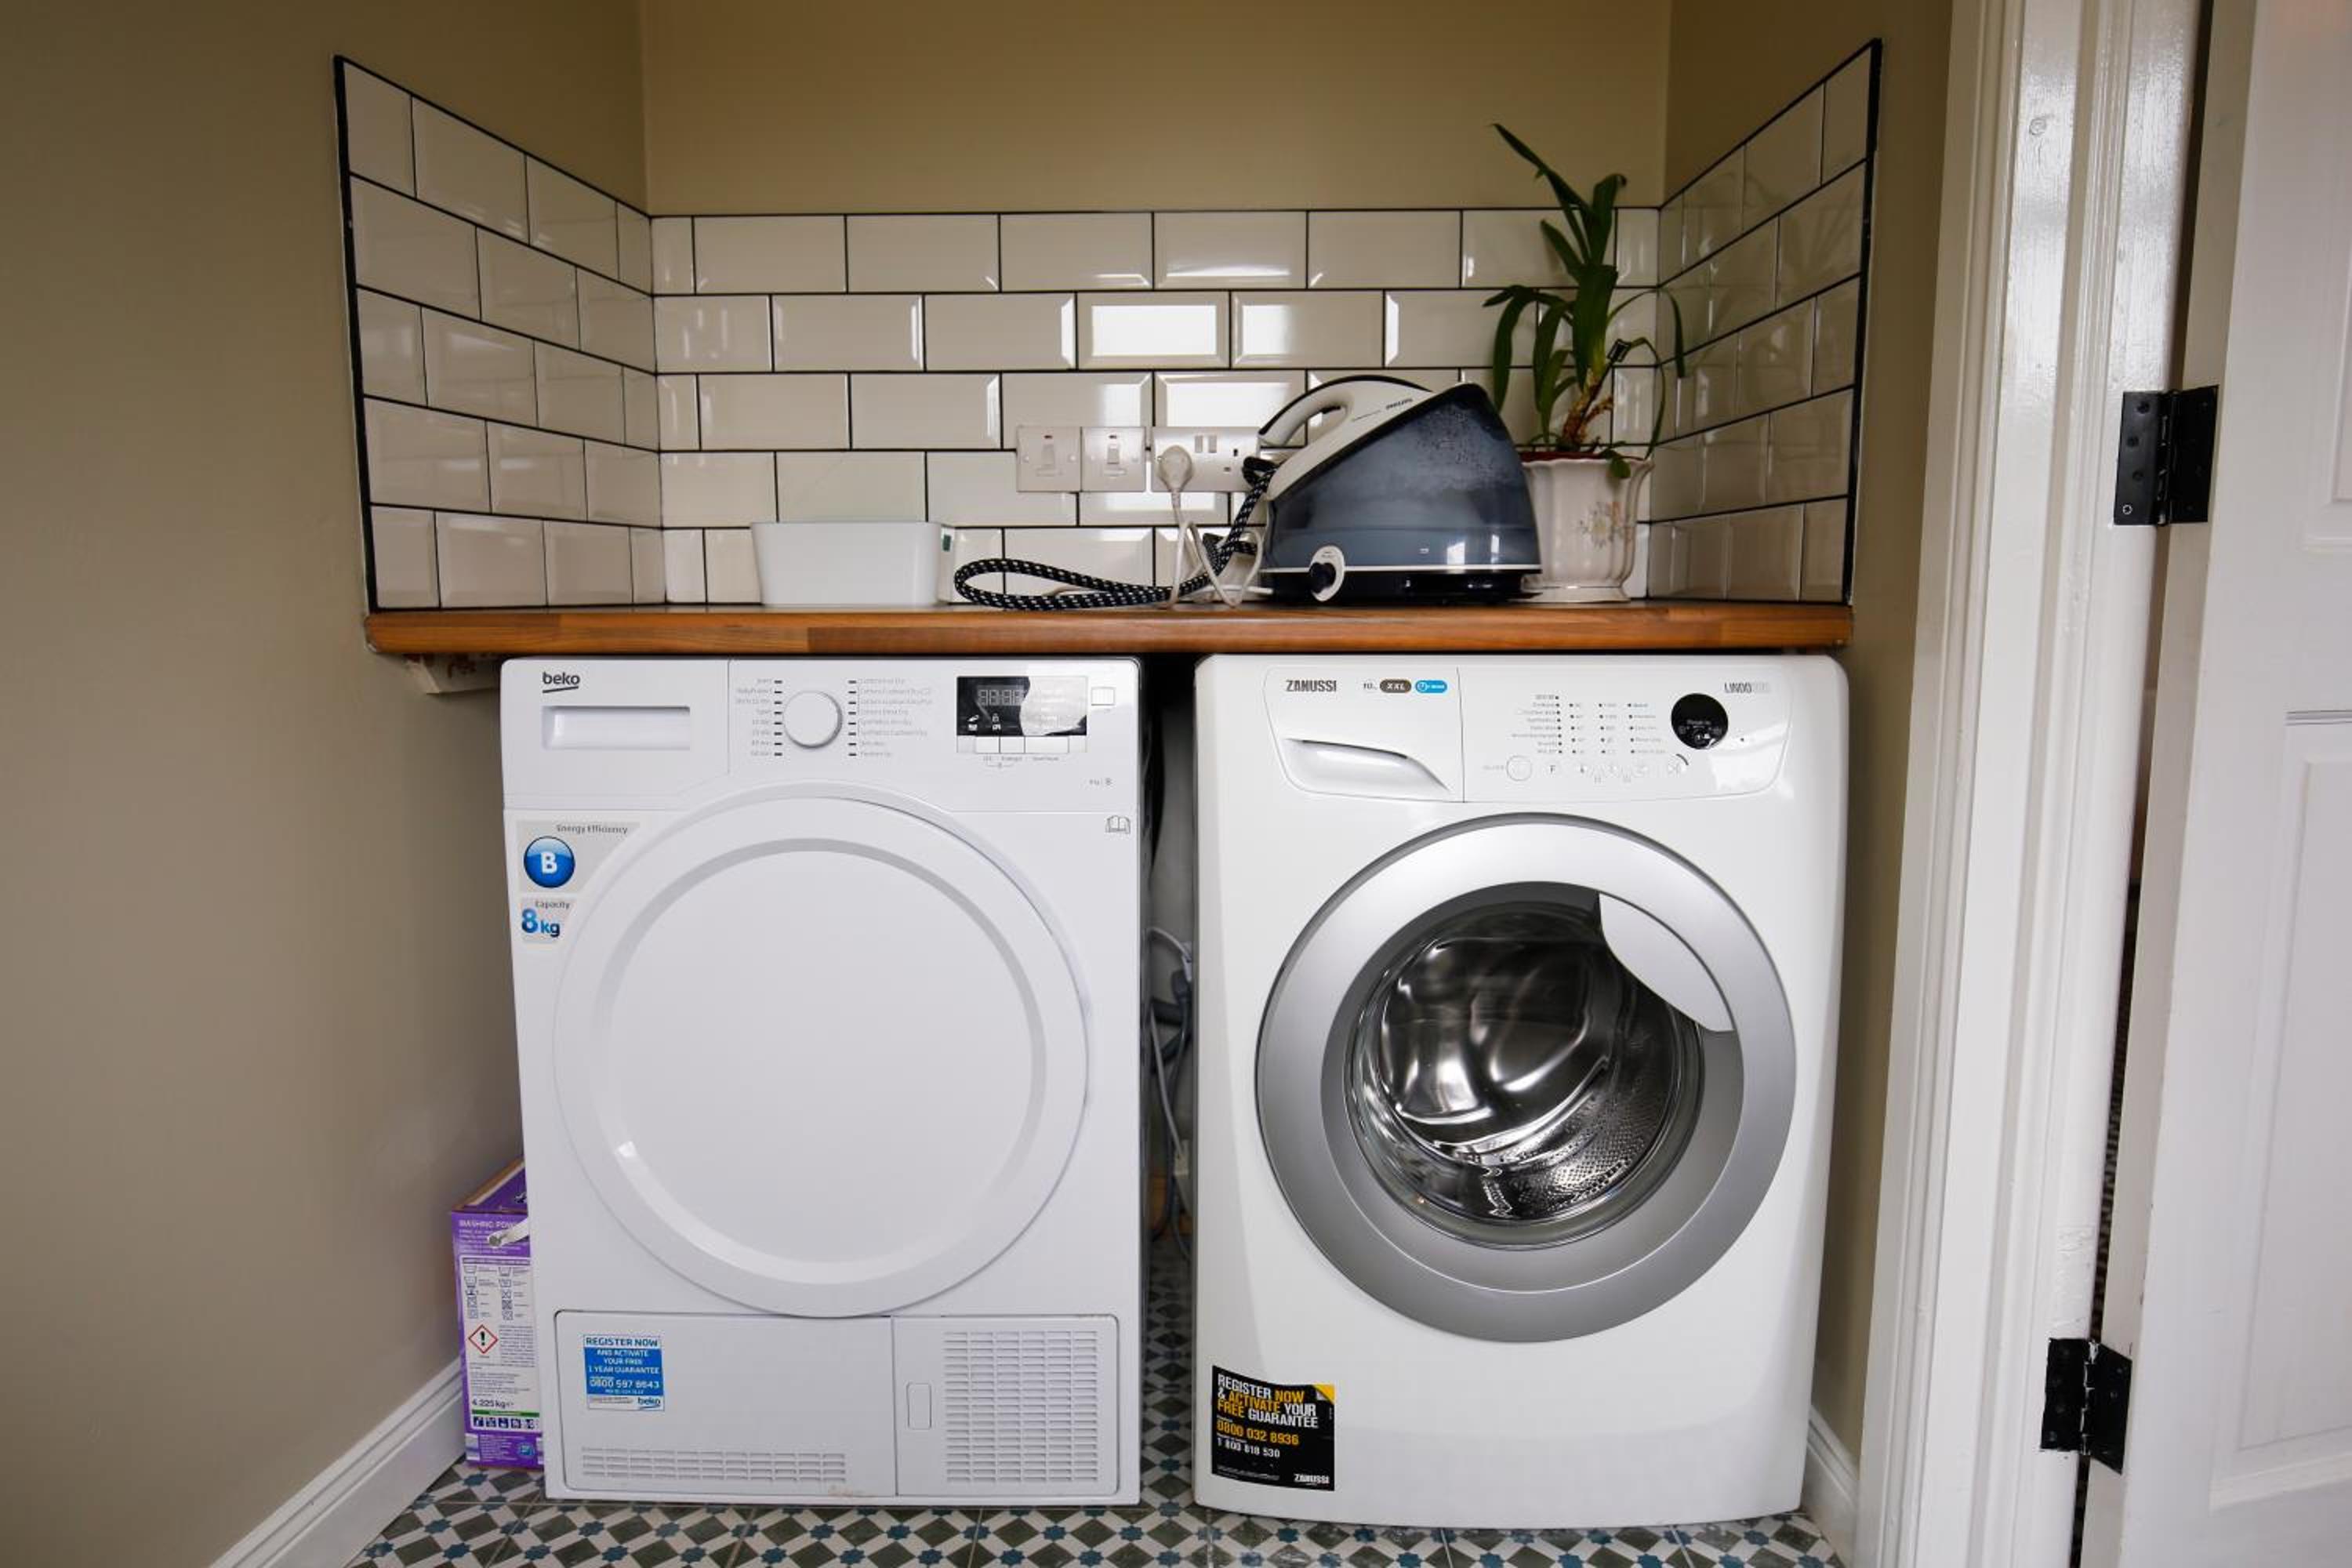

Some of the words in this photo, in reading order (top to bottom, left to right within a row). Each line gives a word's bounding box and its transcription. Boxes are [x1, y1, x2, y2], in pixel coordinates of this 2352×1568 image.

[543, 671, 581, 686] beko
[1286, 680, 1337, 692] ZANUSSI
[557, 825, 586, 835] Energy
[587, 824, 628, 834] Efficiency
[540, 851, 558, 875] B
[535, 902, 571, 910] Capacity
[586, 1337, 633, 1346] REGISTER
[634, 1338, 658, 1347] NOW
[1218, 1374, 1271, 1399] REGISTER
[1274, 1389, 1305, 1403] NOW
[637, 1396, 661, 1406] beko
[1218, 1388, 1225, 1399] &
[1228, 1390, 1280, 1414] ACTIVATE
[1284, 1403, 1316, 1417] YOUR
[1218, 1399, 1245, 1418] FREE
[1247, 1408, 1319, 1428] GUARANTEE
[1217, 1420, 1244, 1437] 0800
[1247, 1427, 1268, 1442] 032
